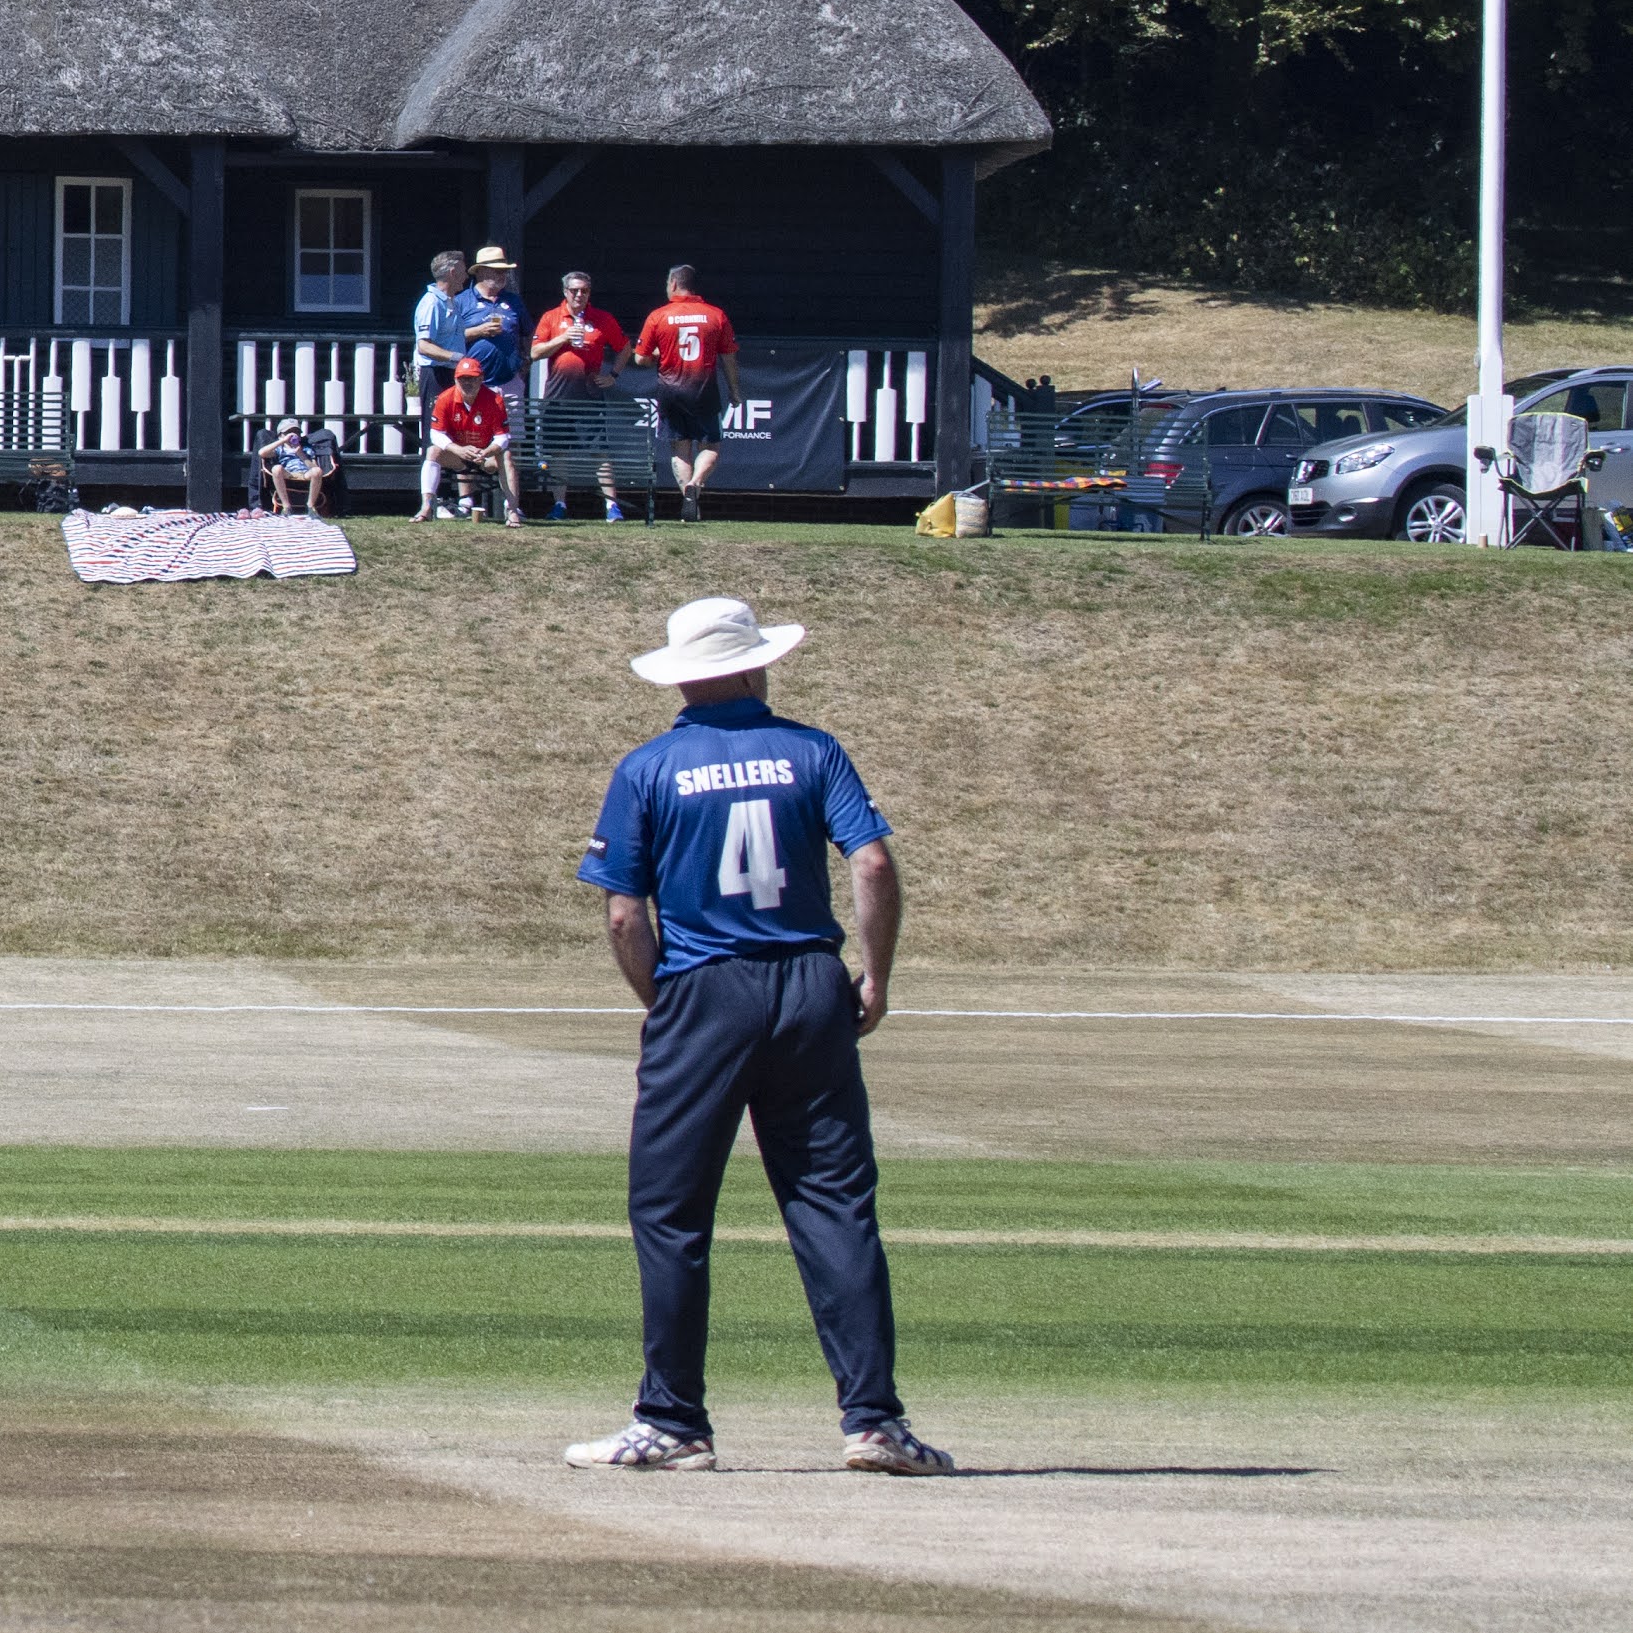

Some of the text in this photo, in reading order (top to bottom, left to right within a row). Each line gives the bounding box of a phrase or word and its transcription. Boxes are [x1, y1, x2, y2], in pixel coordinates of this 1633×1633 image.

[678, 326, 700, 361] 5
[722, 400, 772, 430] MF
[723, 431, 772, 440] FORMANCE
[675, 758, 794, 796] SNELLERS
[717, 799, 787, 911] 4
